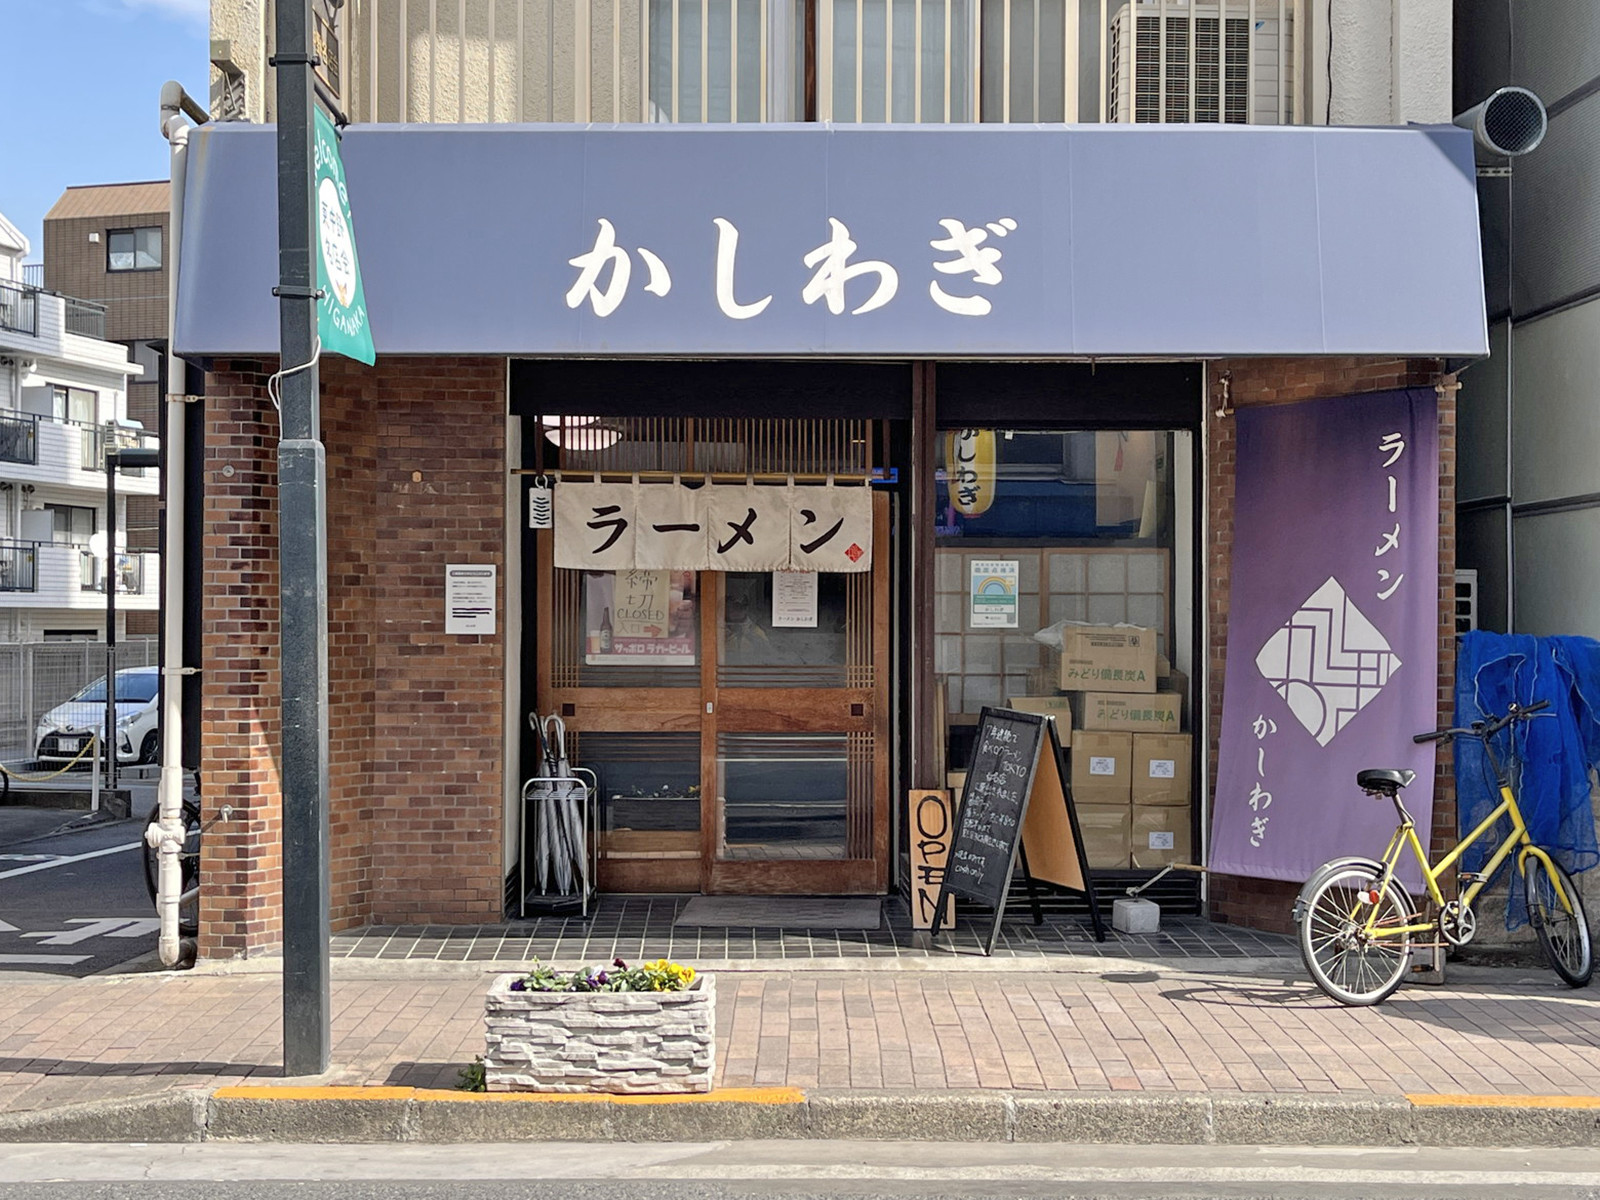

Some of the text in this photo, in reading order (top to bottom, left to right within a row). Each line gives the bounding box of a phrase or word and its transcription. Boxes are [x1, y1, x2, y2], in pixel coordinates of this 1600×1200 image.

[566, 217, 1018, 320] かしわぎ
[586, 504, 845, 555] ラーメン
[1374, 432, 1405, 601] ラーメン
[616, 608, 665, 621] CLOSED
[617, 622, 640, 634] 入口
[614, 644, 691, 654] サッポロ ラガービール
[1067, 668, 1147, 682] みどり備長炭A
[1002, 761, 1027, 778] TOKYO
[1248, 714, 1277, 848] かしわぎ
[917, 795, 948, 925] OPEN
